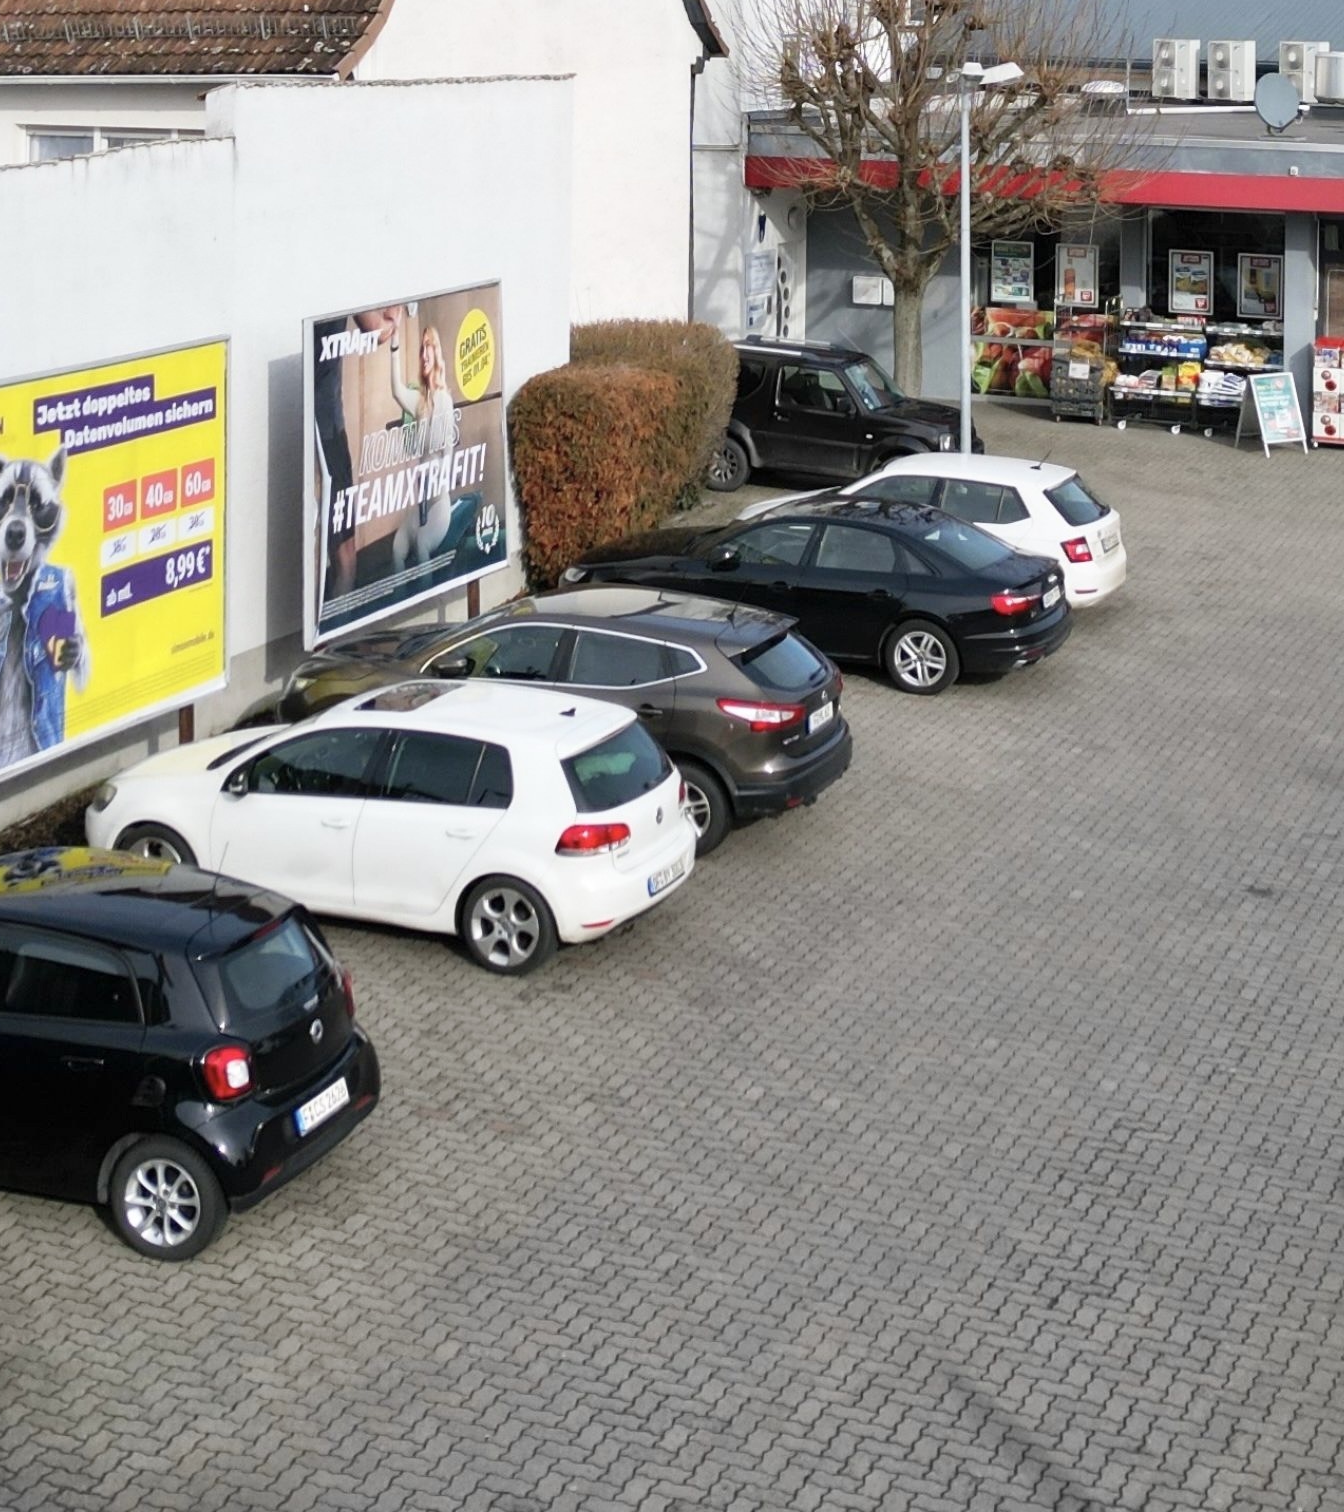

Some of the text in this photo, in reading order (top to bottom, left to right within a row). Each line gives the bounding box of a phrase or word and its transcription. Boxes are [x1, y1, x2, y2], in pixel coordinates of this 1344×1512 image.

[319, 328, 383, 362] XTRAFIT
[460, 323, 487, 360] GRATIS
[37, 385, 151, 426] Jetzt doppeltes
[64, 398, 214, 449] Datenvolumen sichern
[358, 418, 428, 477] KOMM
[333, 442, 487, 535] #TEAMXTRAFIT!
[482, 504, 496, 528] 10
[165, 550, 195, 588] 8,99
